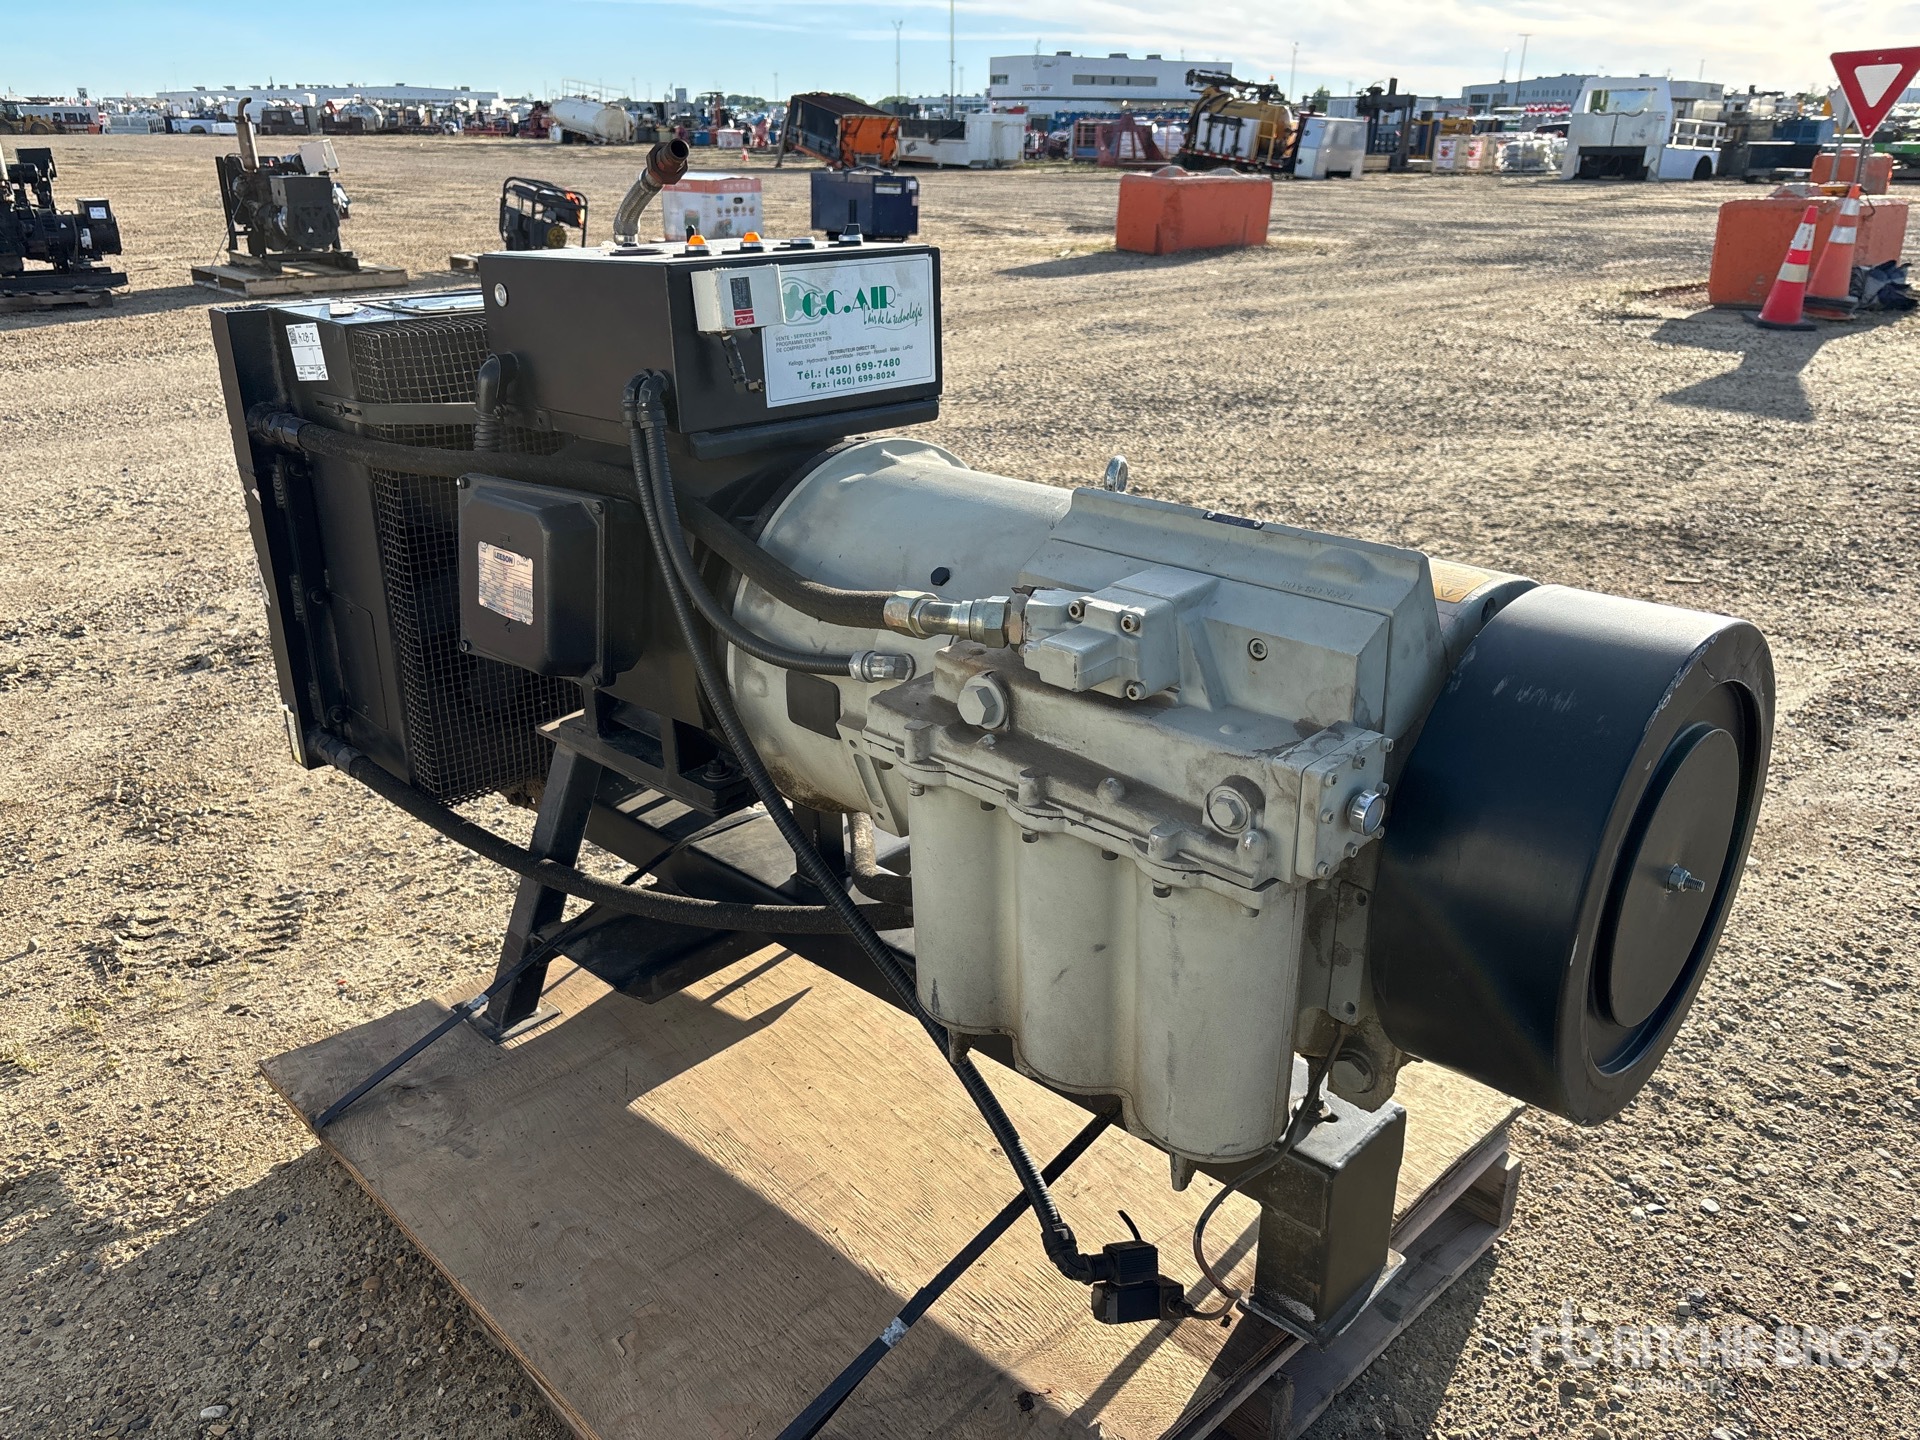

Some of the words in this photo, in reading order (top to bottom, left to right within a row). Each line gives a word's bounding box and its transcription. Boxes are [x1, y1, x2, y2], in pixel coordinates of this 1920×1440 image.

[776, 339, 803, 348] PROGRAMME
[805, 336, 832, 344] D'ENTRETIEN
[783, 344, 816, 353] COMPRESSEUR
[828, 347, 855, 356] DISTRIBUTEUR
[797, 369, 821, 381] Tél.:
[825, 364, 851, 379] (450)
[855, 357, 900, 372] 699-7480
[811, 380, 830, 391] Fax:
[833, 376, 855, 388] (450)
[858, 370, 895, 383] 699-8024
[494, 551, 513, 564] LEESON
